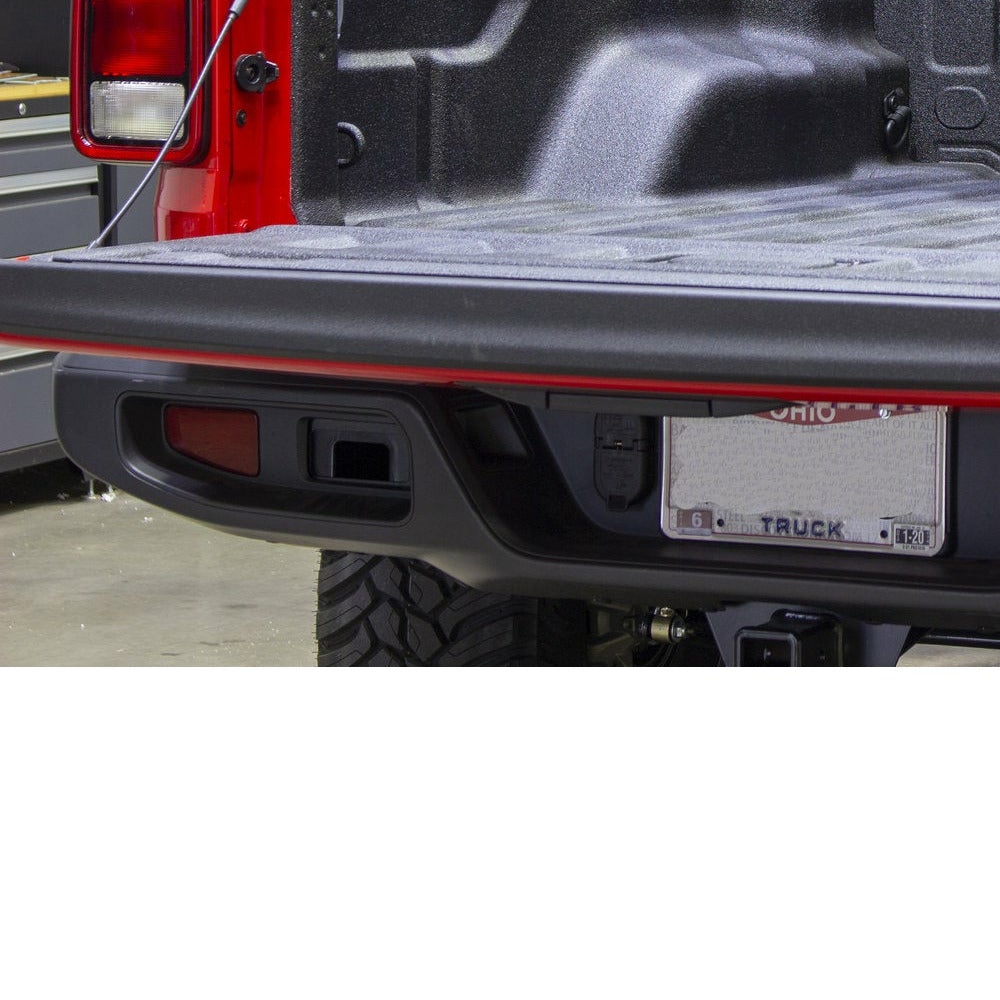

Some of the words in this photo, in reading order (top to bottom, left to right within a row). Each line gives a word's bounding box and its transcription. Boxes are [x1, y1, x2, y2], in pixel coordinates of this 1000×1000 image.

[769, 406, 836, 423] OHIO
[691, 512, 703, 528] 6
[761, 516, 845, 538] TRUCK
